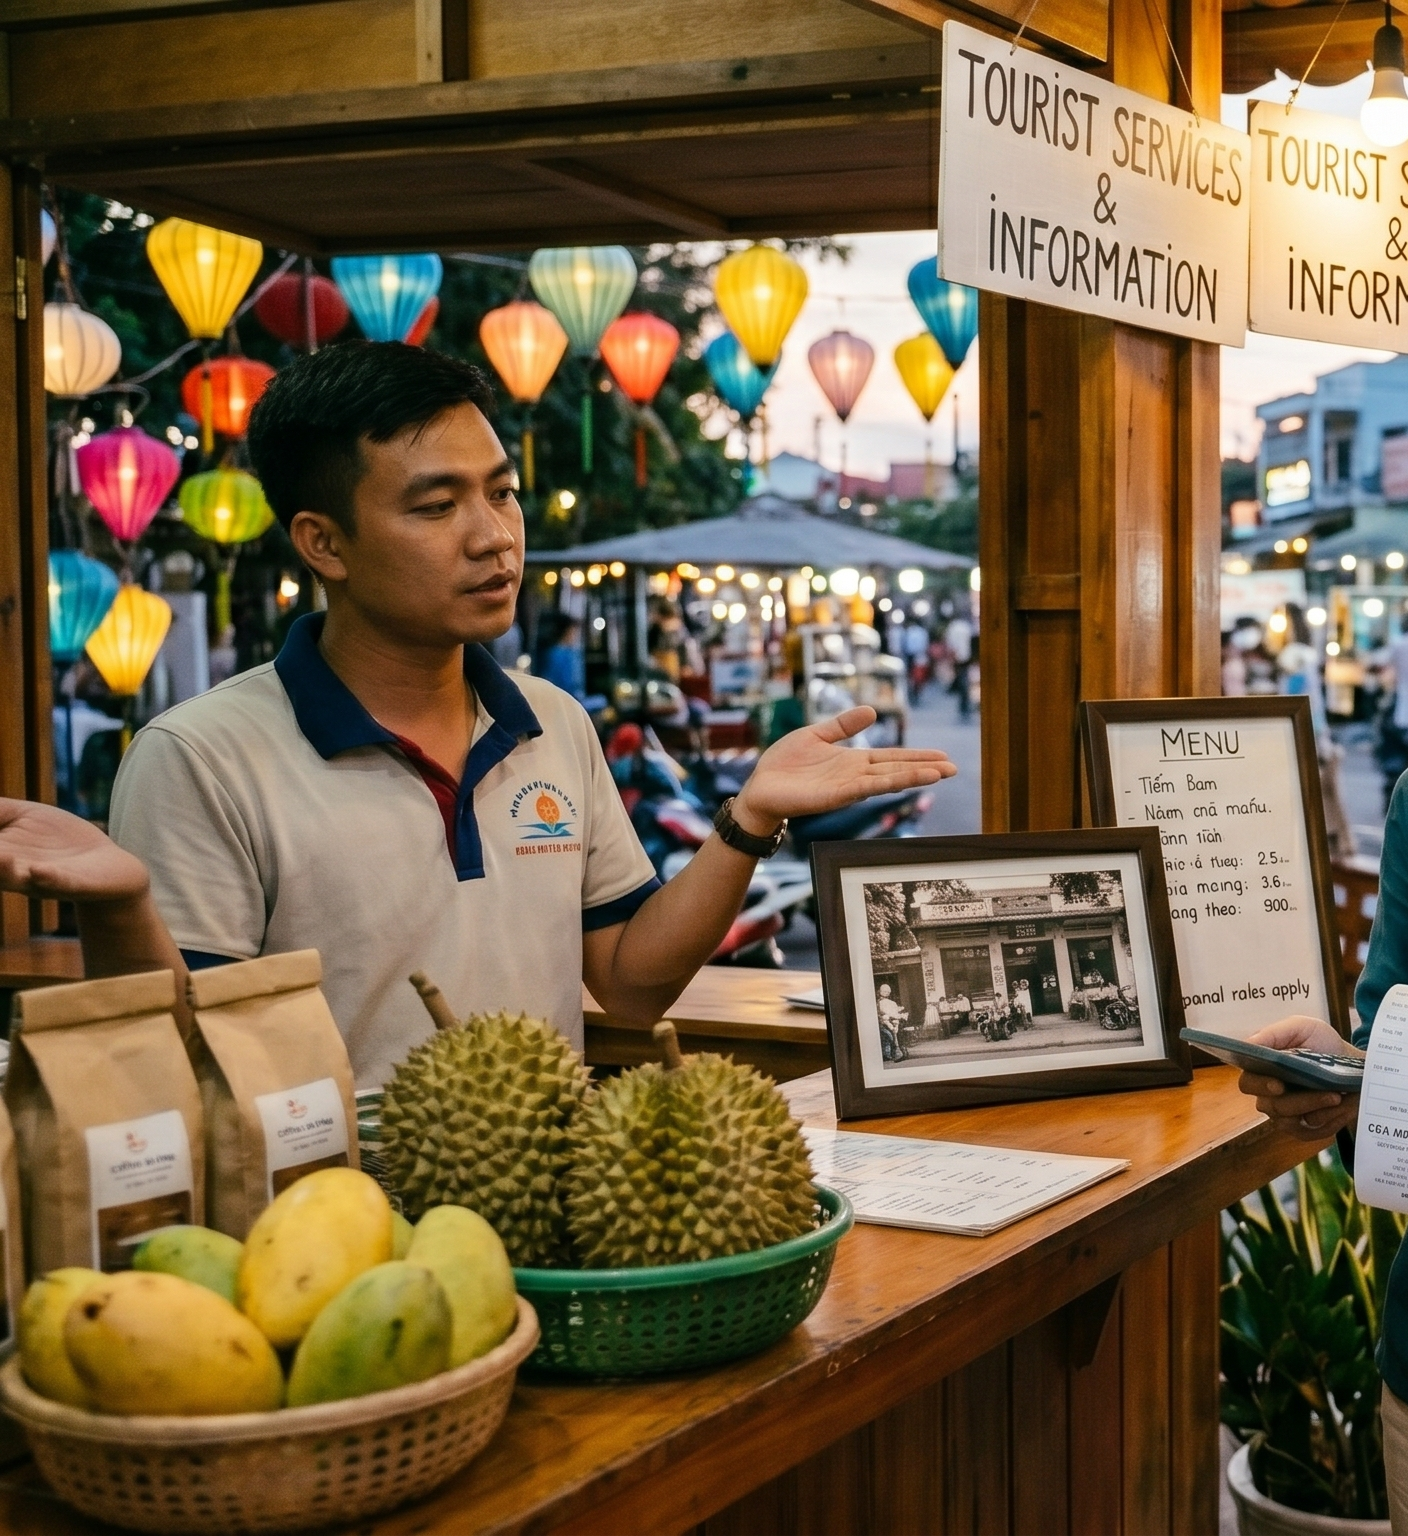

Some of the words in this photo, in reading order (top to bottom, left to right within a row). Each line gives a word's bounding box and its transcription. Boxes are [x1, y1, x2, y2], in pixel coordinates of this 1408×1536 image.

[1257, 128, 1388, 204] TOURIST
[1093, 172, 1117, 227] &
[1385, 216, 1408, 262] &
[1186, 773, 1218, 792] Bam
[1272, 978, 1310, 1001] apply
